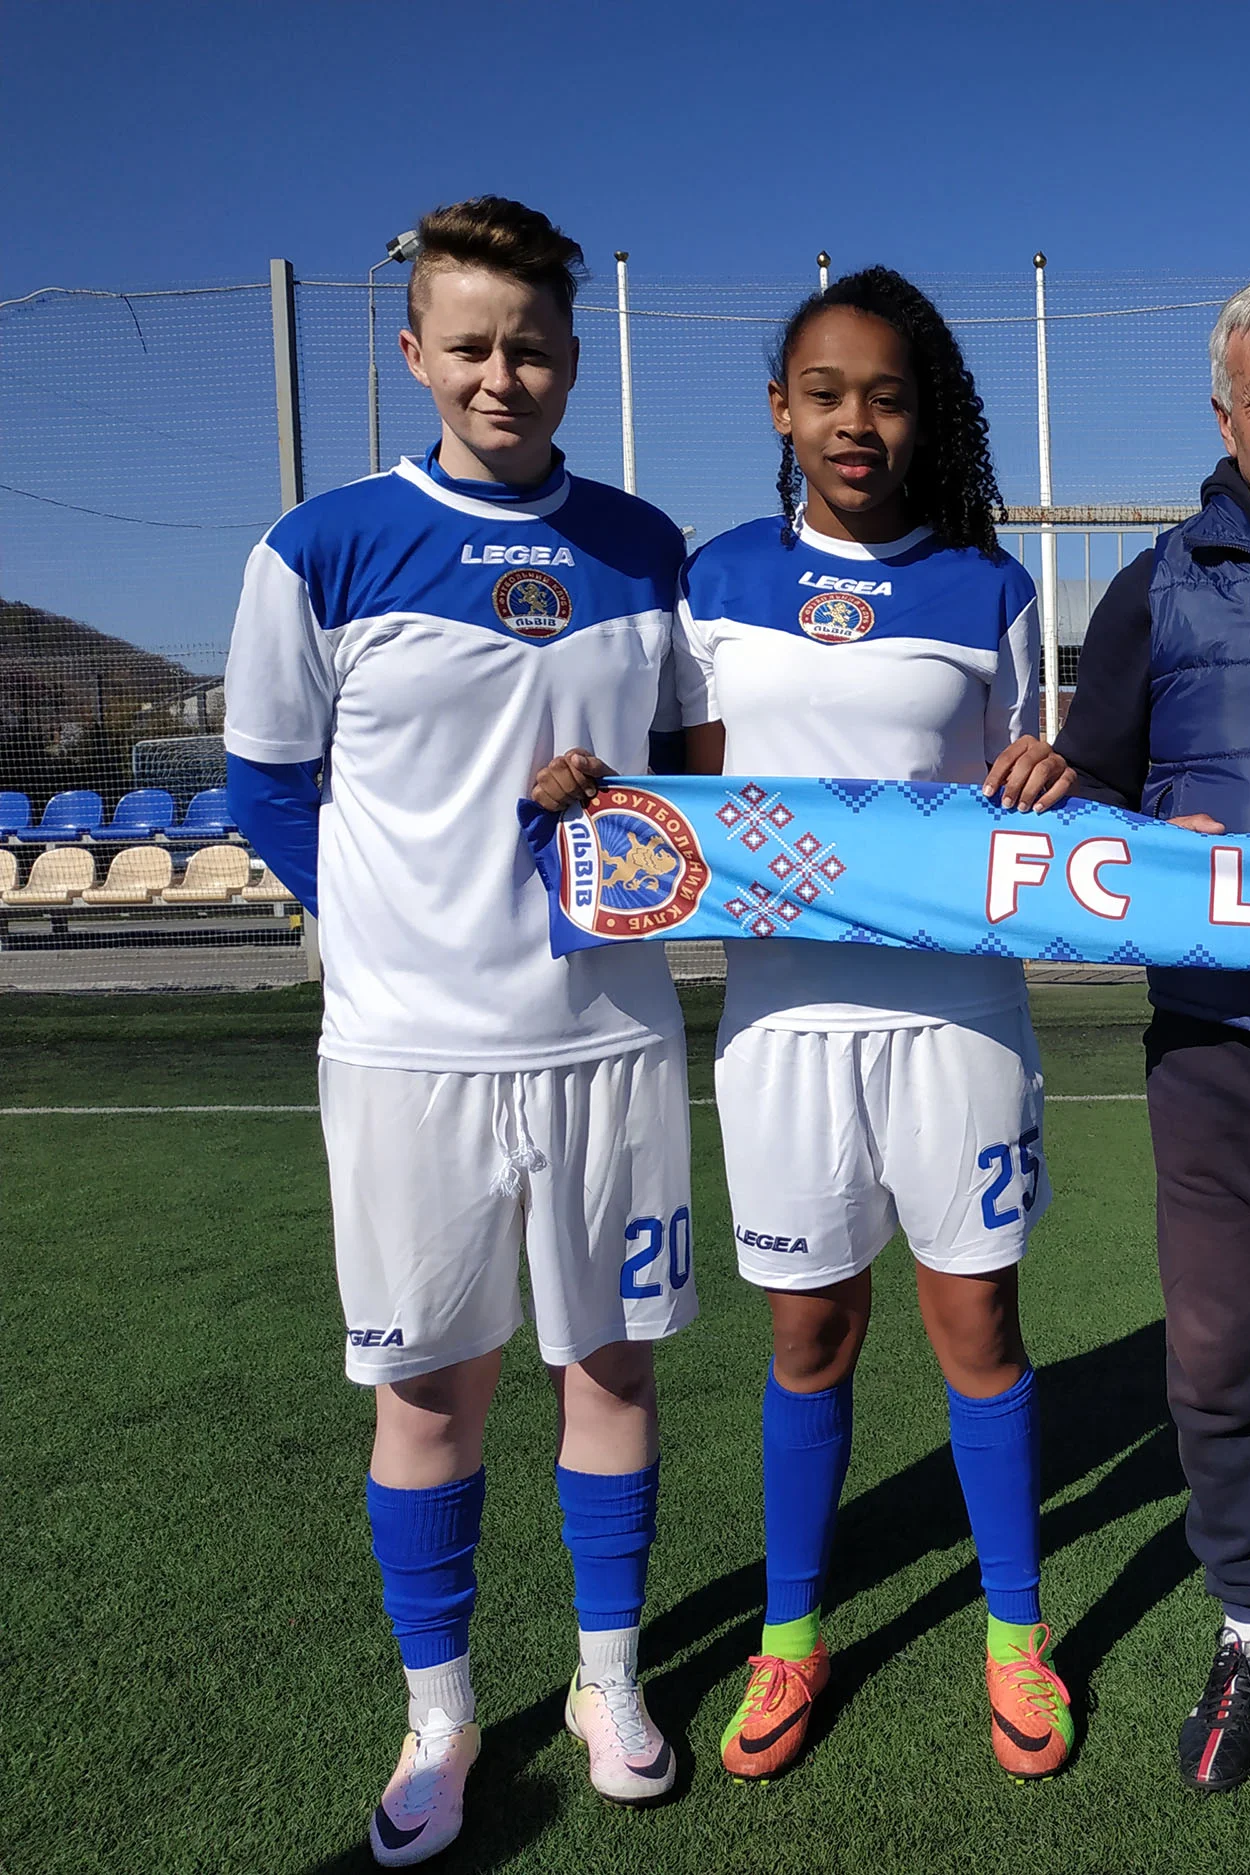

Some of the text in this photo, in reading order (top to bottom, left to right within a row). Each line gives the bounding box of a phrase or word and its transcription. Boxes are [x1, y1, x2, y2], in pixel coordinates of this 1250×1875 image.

[461, 544, 576, 567] LEGEA
[798, 571, 892, 596] LEGEA
[515, 617, 556, 627] ЛЬВІВ
[568, 822, 594, 908] ЛЬВІВ
[611, 792, 703, 930] ФУТБОЛЬНИЙ КЛУБ
[985, 829, 1132, 924] FC
[978, 1125, 1040, 1230] 25
[619, 1203, 692, 1300] 20
[736, 1223, 809, 1254] LEGEA
[347, 1327, 405, 1347] GEA
